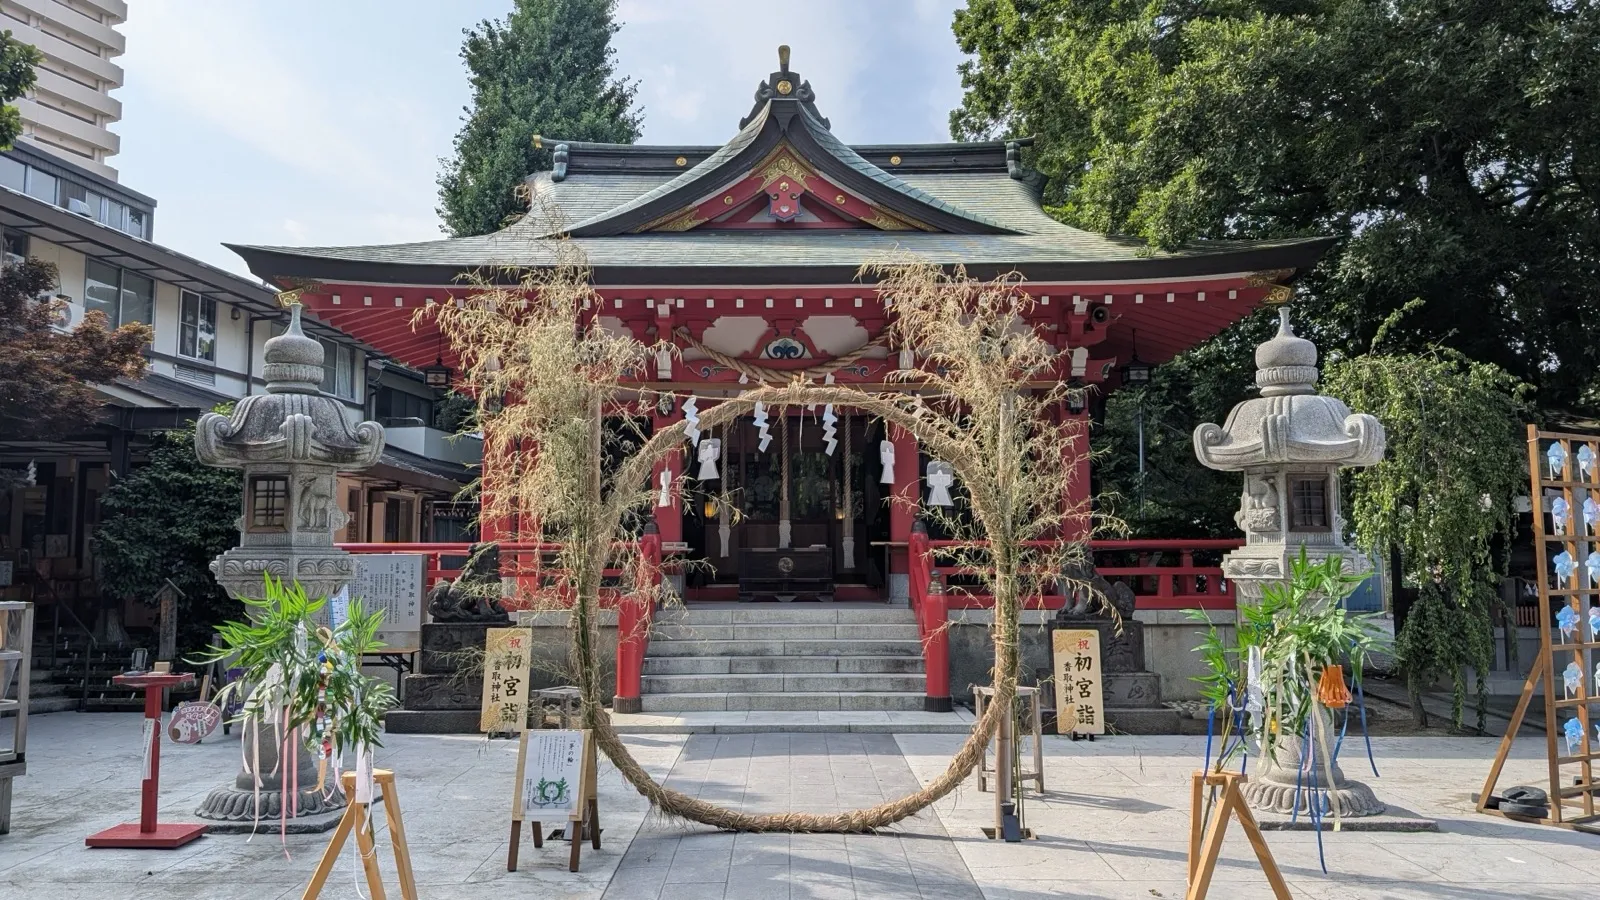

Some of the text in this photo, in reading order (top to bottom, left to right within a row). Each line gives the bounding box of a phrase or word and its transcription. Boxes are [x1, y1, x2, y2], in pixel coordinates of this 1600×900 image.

[509, 638, 521, 649] 祝
[1077, 639, 1090, 650] 祝
[491, 660, 501, 703] 香取神社
[501, 651, 522, 724] 初宮詣
[1063, 662, 1075, 705] 香取神社
[1074, 652, 1096, 725] 初宮詣
